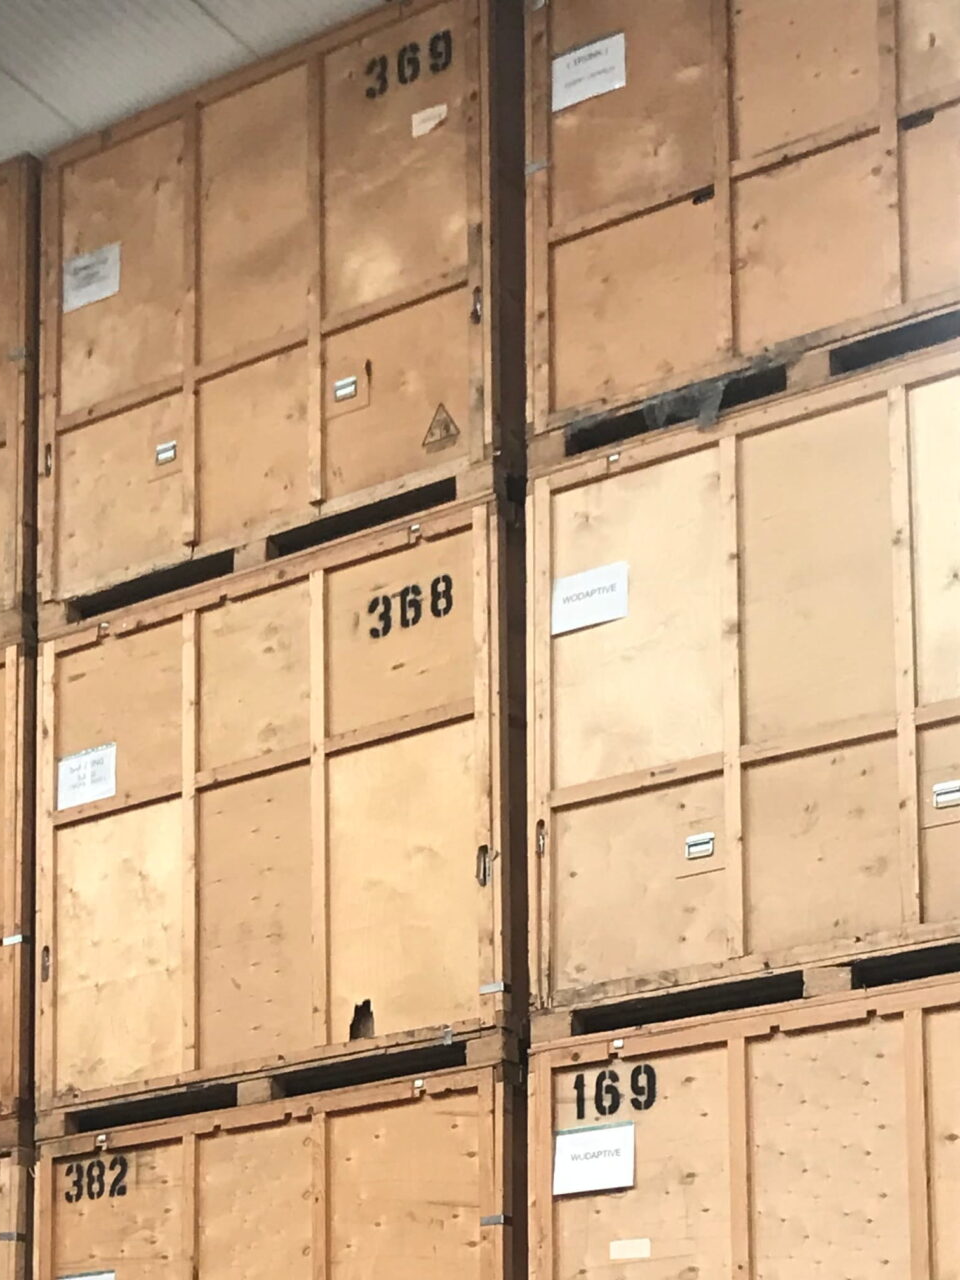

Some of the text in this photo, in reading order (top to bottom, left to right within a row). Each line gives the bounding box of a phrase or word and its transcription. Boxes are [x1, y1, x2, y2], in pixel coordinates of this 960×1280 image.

[365, 29, 452, 98] 369
[368, 574, 453, 639] 368
[573, 1064, 656, 1120] 169
[65, 1156, 128, 1203] 382
